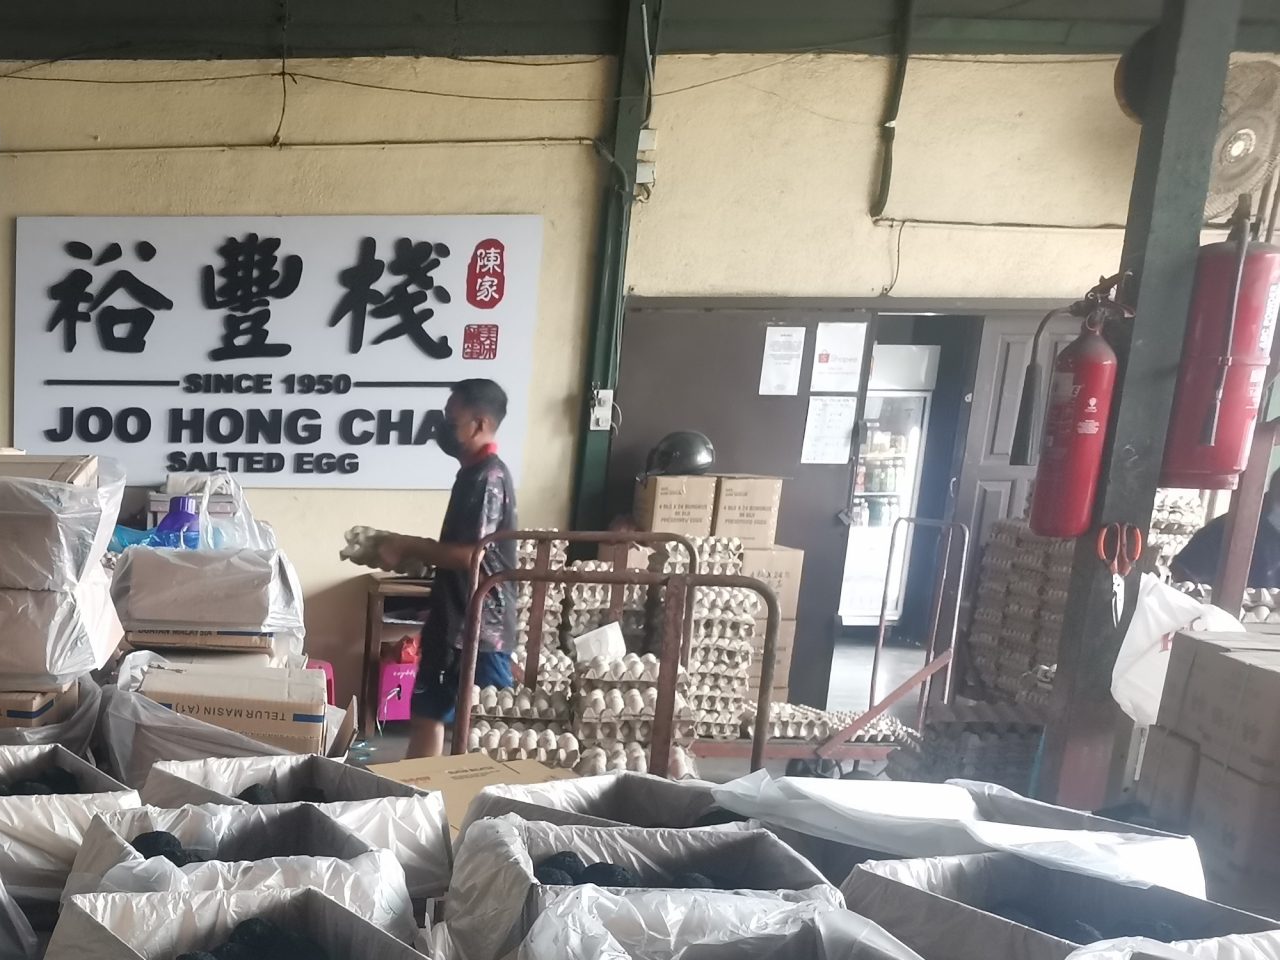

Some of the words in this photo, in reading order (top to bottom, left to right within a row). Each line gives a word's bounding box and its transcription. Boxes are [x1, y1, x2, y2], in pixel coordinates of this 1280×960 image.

[475, 246, 502, 303] 陳家
[182, 373, 273, 394] SINCE
[280, 373, 353, 395] 1950
[44, 406, 152, 444] JOO
[167, 407, 323, 446] HONG
[338, 408, 449, 446] CHA
[166, 451, 285, 473] SALTED
[293, 452, 360, 474] EGG
[175, 703, 200, 715] (A1)
[203, 706, 245, 718] MASIN
[246, 709, 286, 721] TELUR
